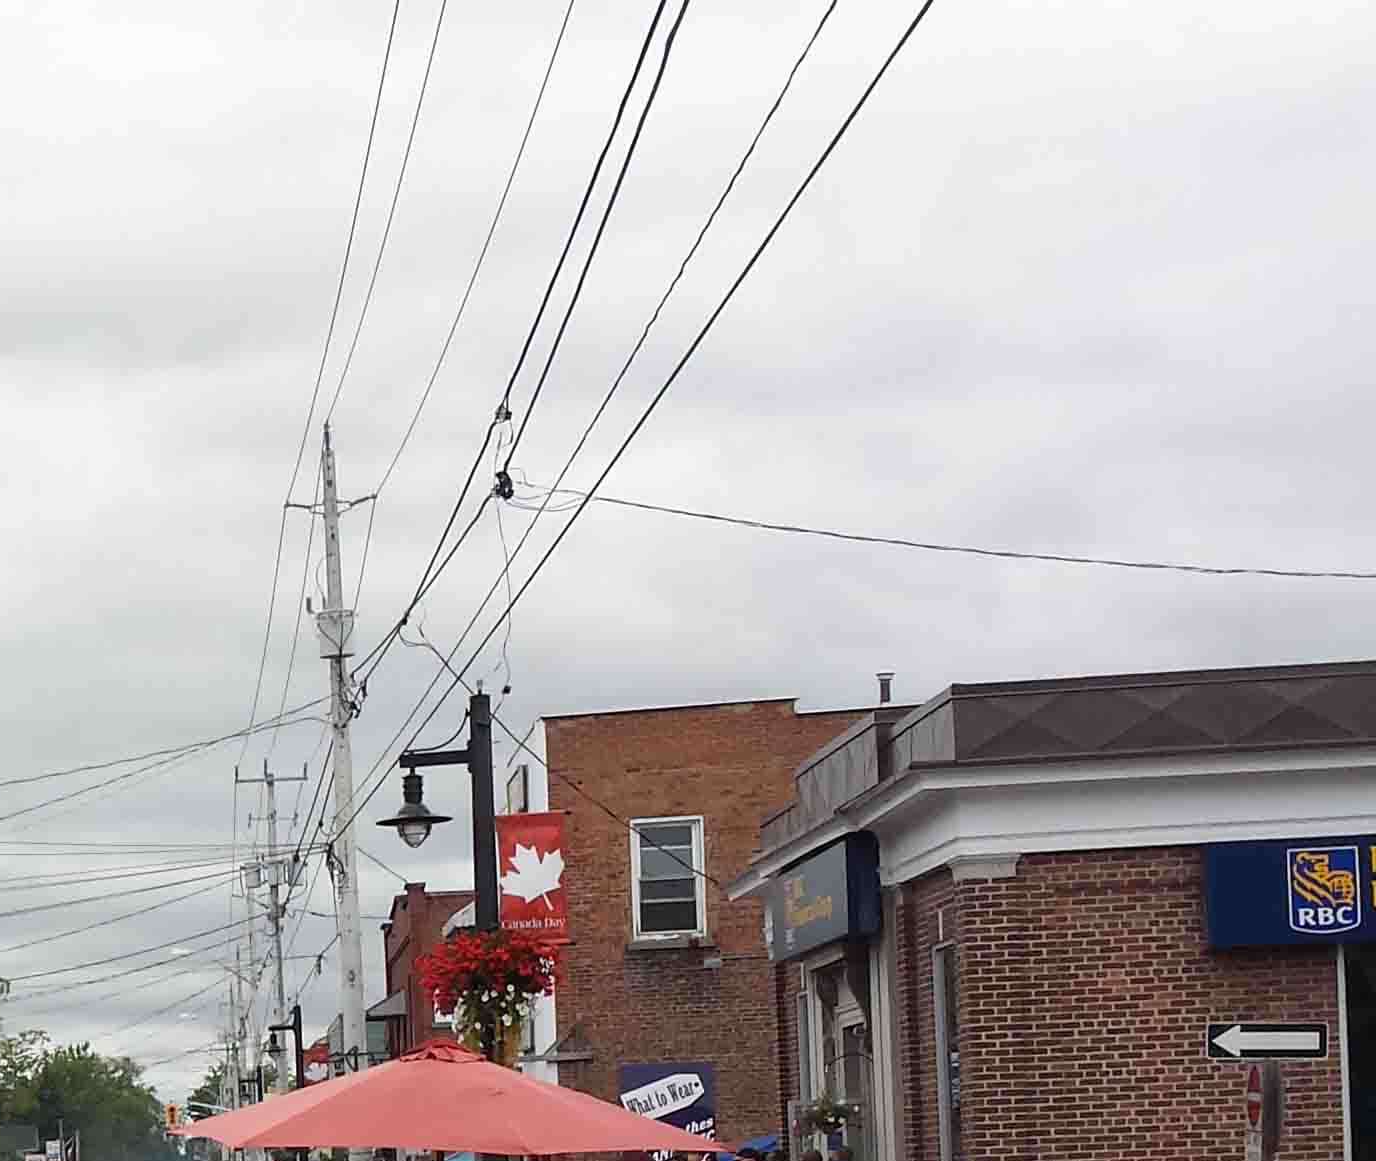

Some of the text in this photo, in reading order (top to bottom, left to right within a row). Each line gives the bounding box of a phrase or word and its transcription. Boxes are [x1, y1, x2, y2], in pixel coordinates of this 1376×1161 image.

[544, 916, 566, 929] Day
[1298, 906, 1353, 925] RBC
[626, 1081, 695, 1114] What to Wear
